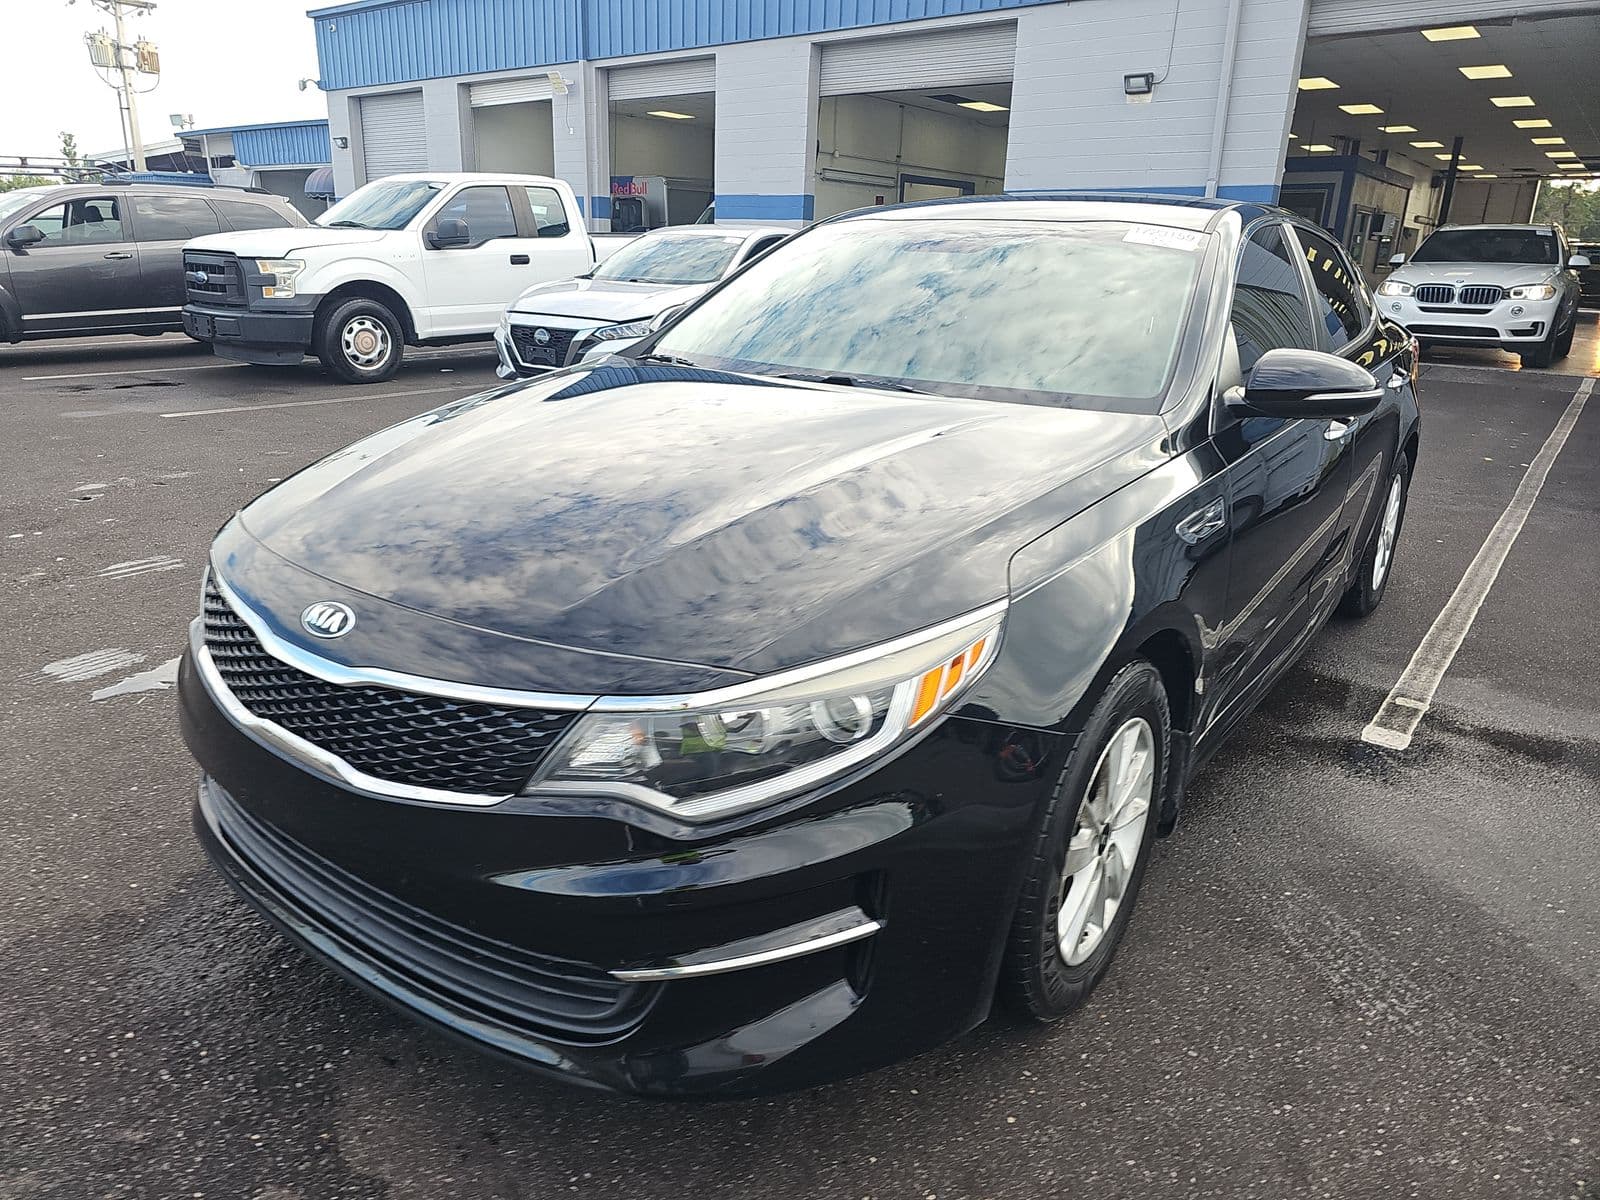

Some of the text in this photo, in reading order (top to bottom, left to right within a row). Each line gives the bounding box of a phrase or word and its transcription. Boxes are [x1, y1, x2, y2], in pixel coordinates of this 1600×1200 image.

[612, 182, 648, 195] Red Bull
[304, 604, 347, 633] KIA
